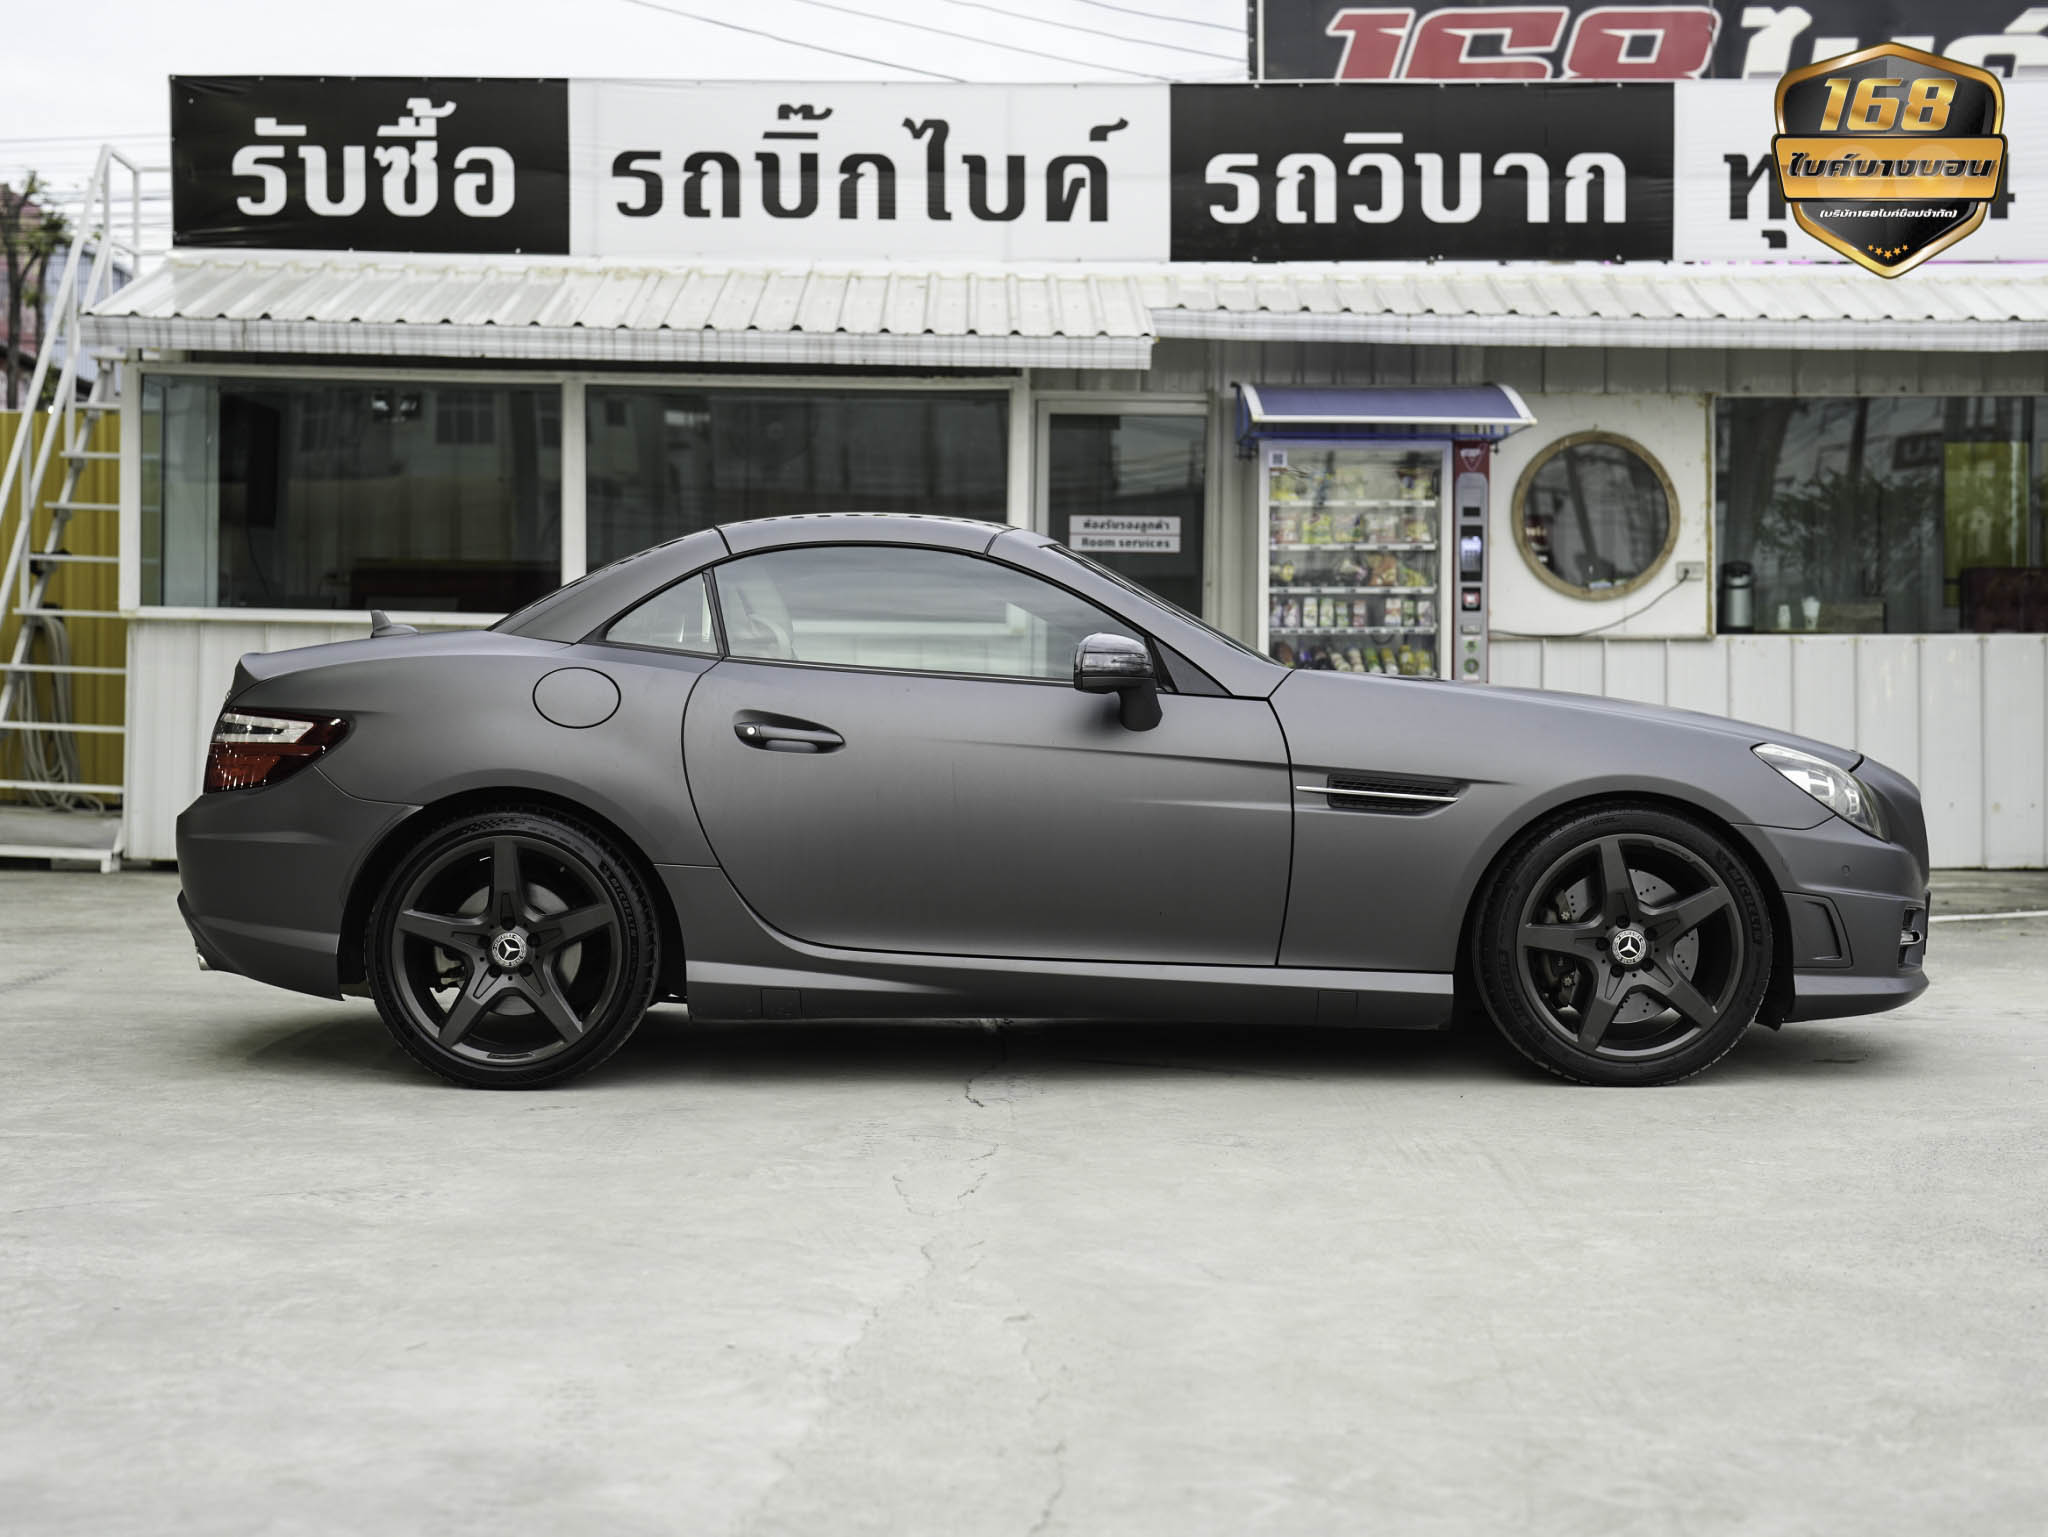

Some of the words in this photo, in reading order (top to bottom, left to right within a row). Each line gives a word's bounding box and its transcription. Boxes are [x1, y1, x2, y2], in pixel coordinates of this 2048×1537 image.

[232, 97, 515, 217] รับซื้อ
[611, 104, 1129, 222] รถบิ๊กไบค์
[1205, 132, 1626, 224] รถวิบาก
[1081, 537, 1115, 548] Room
[1119, 538, 1170, 548] services
